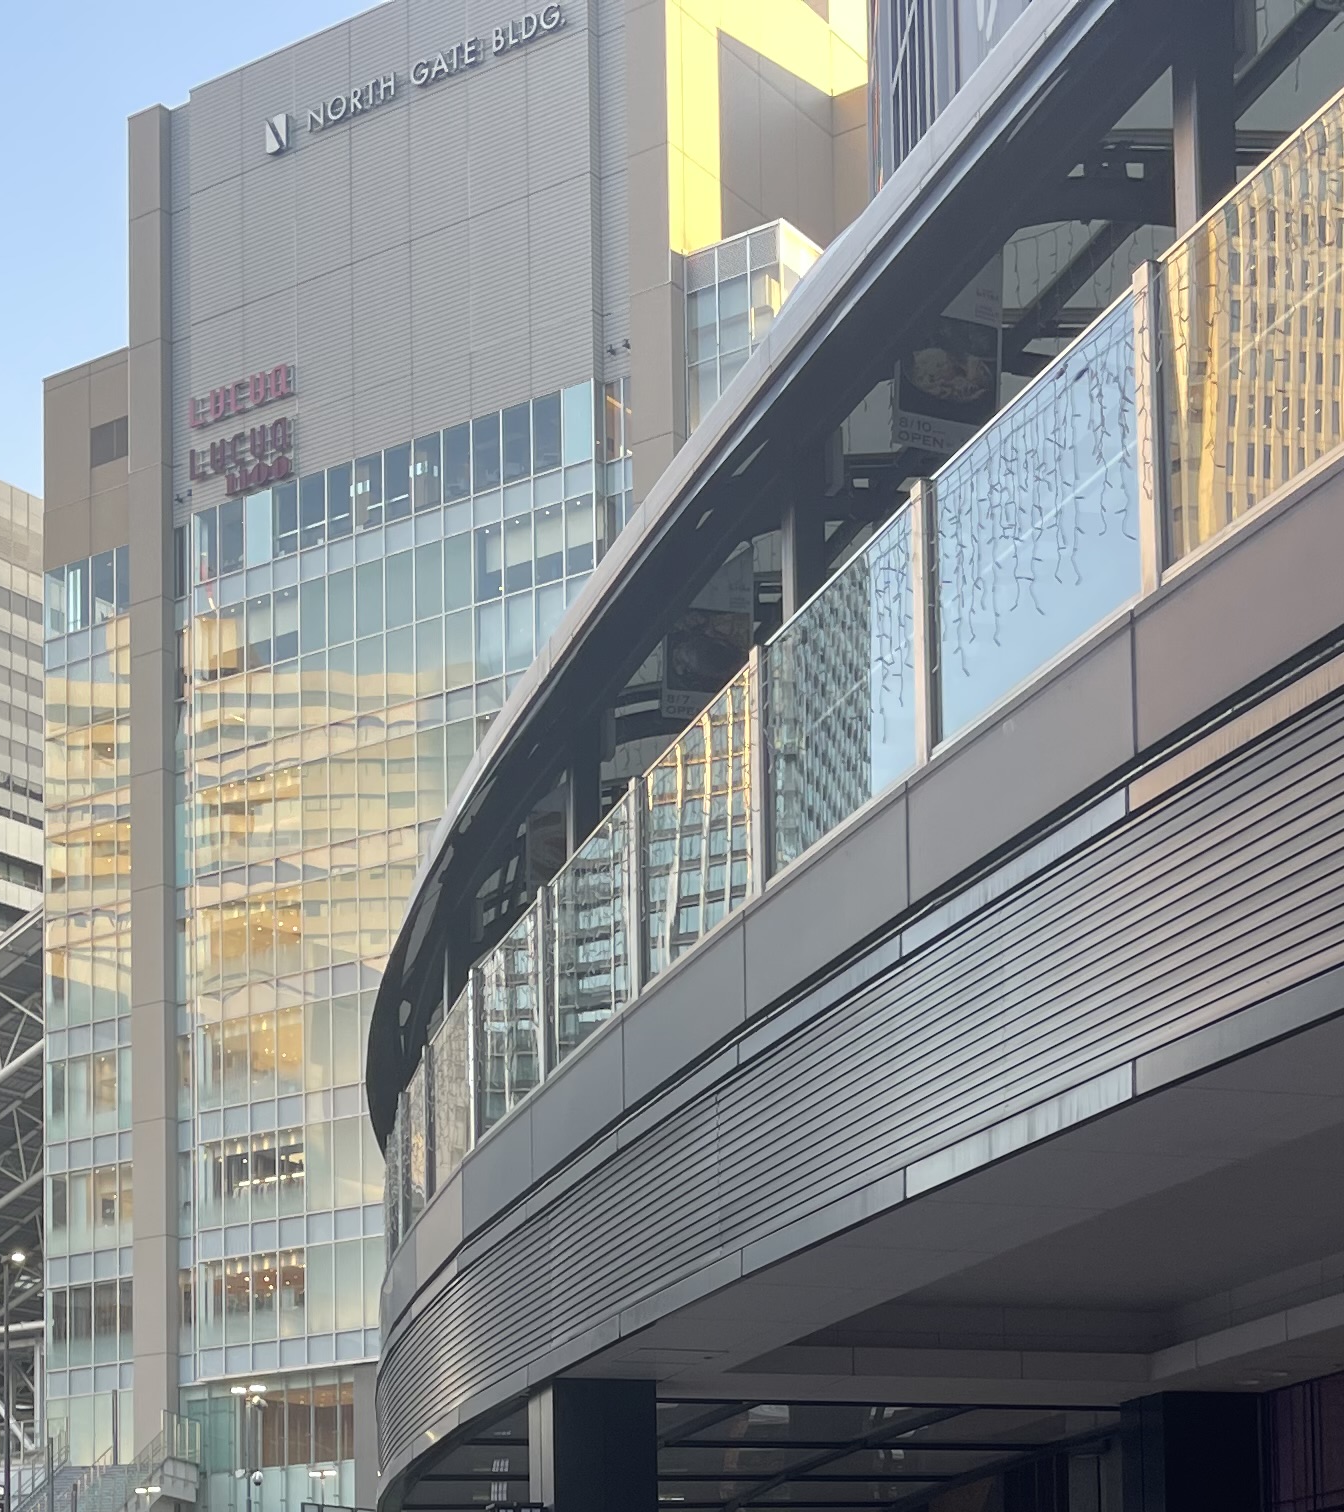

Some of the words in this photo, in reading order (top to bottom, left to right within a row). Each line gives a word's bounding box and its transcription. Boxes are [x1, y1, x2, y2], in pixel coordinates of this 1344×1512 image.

[306, 70, 397, 133] NORTH
[410, 39, 477, 88] GATE
[491, 3, 567, 54] BLDG.
[189, 363, 292, 428] LUCUA
[190, 417, 290, 480] LUCUA
